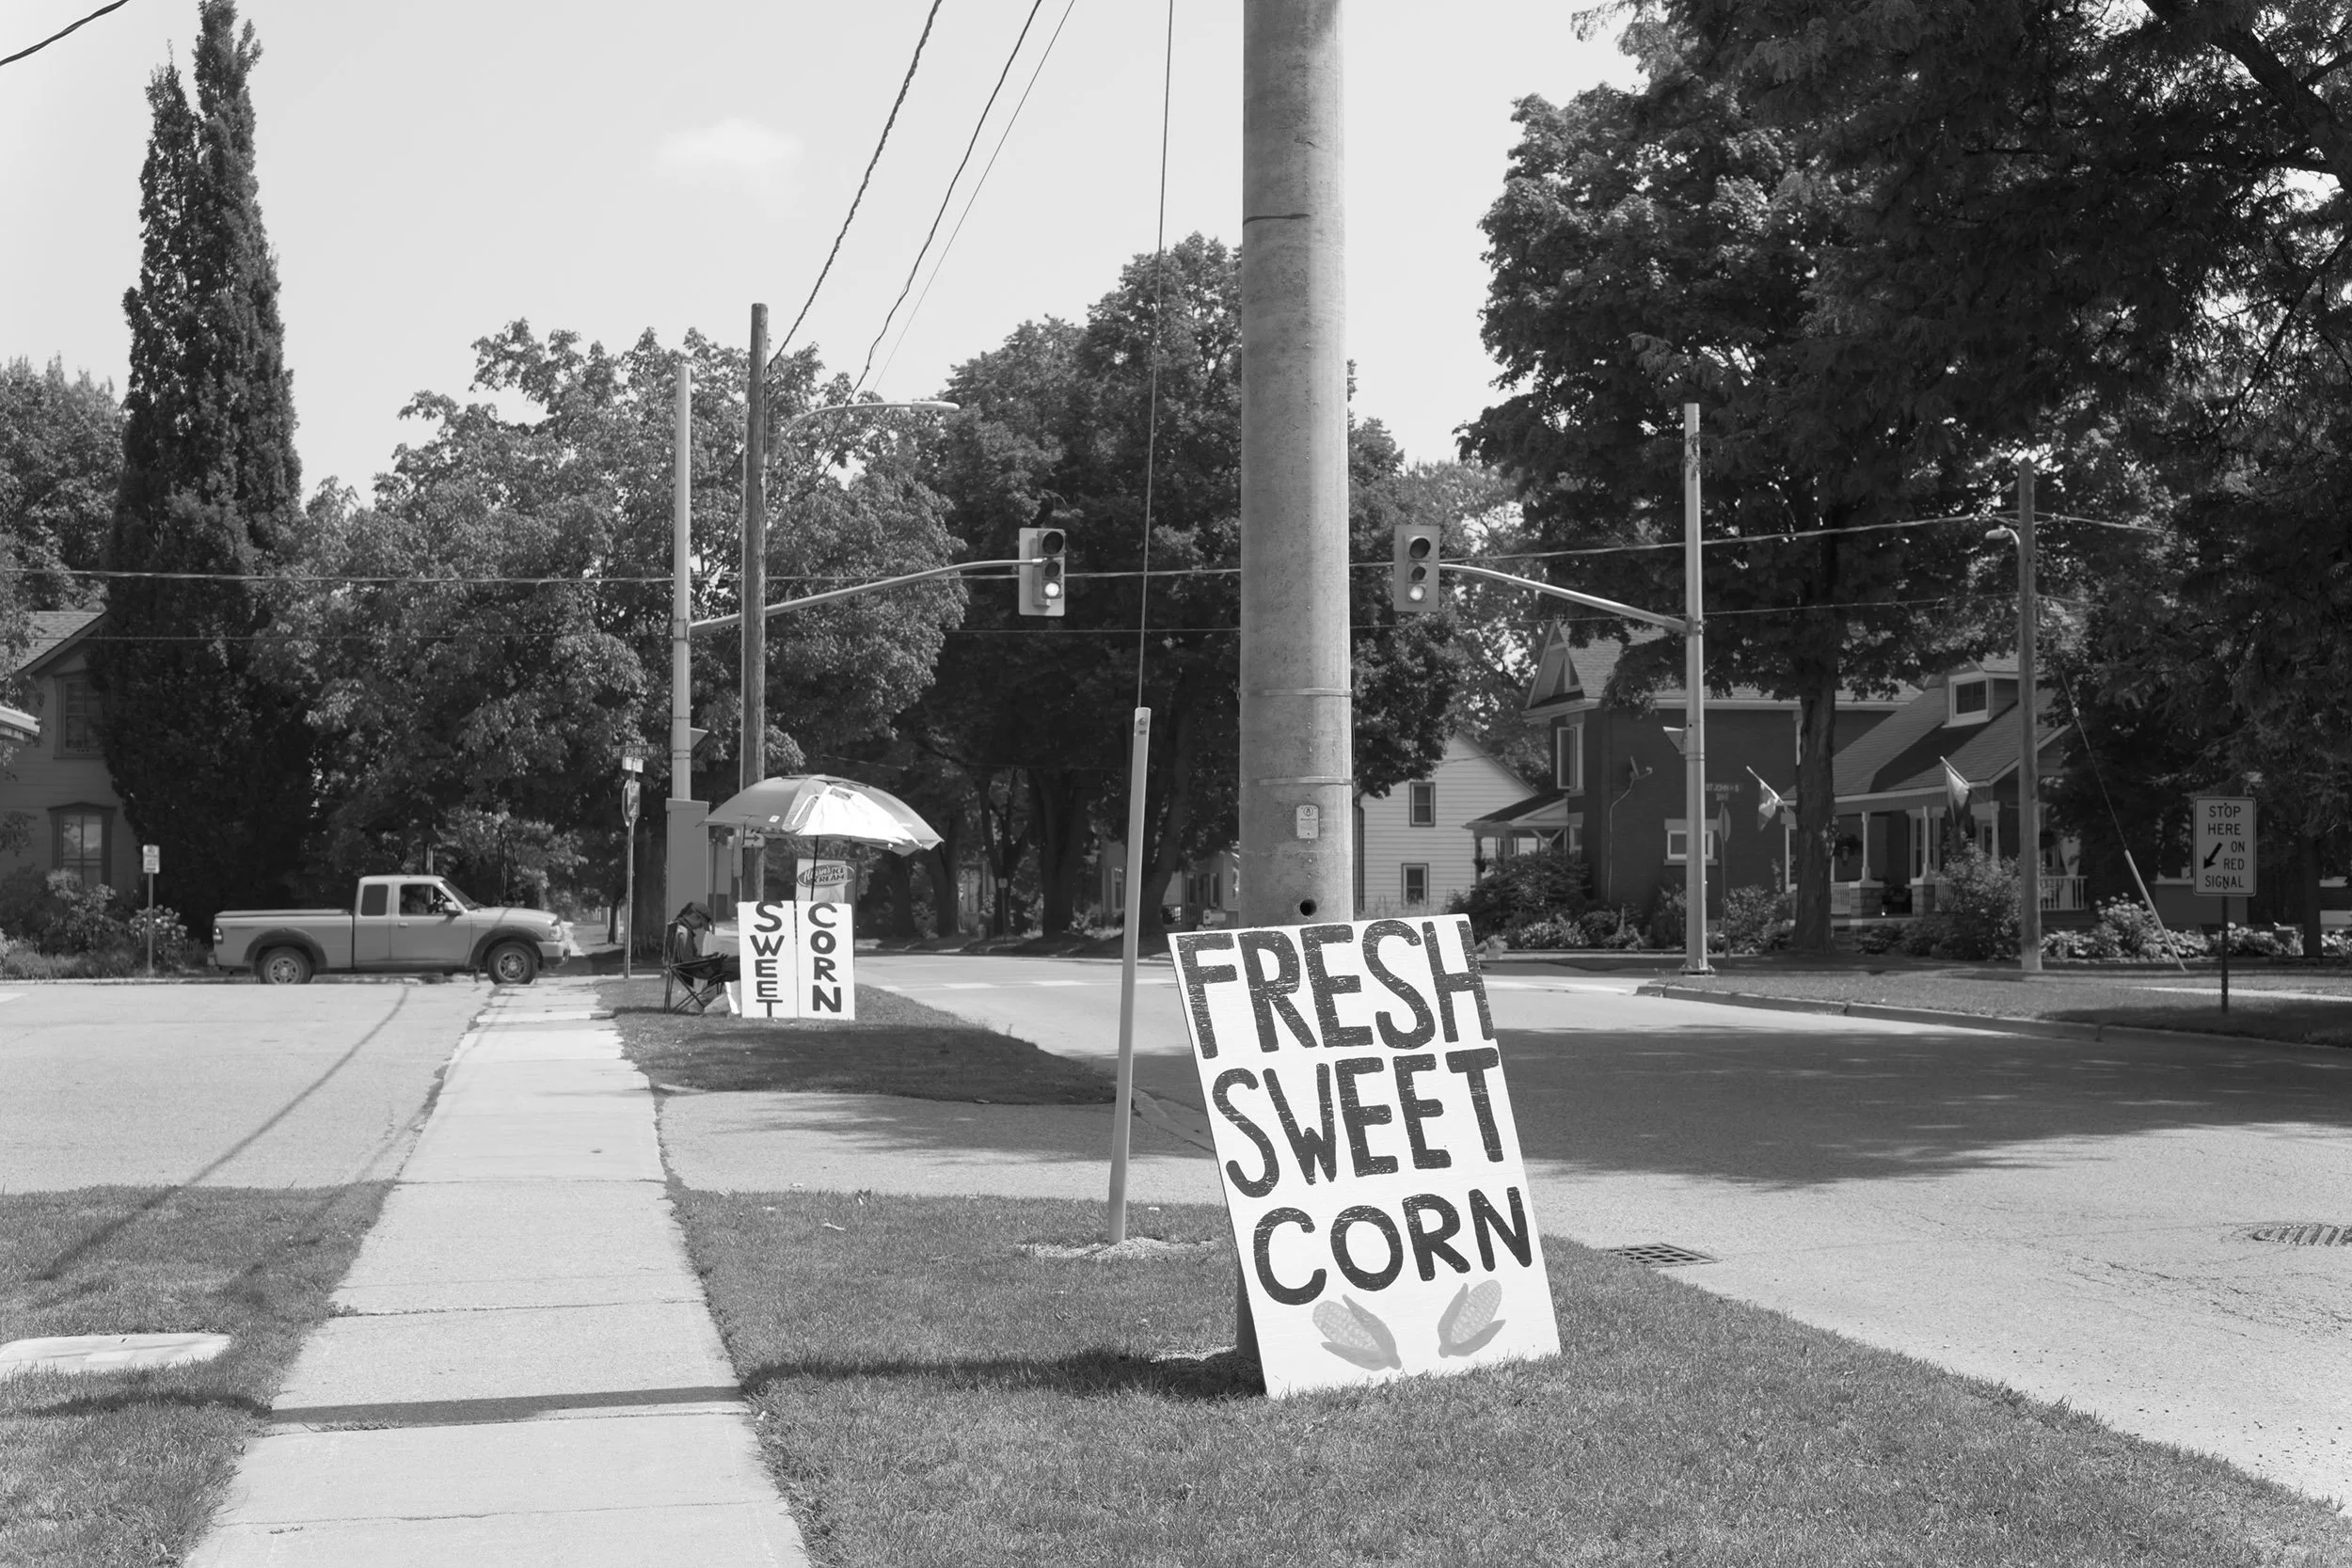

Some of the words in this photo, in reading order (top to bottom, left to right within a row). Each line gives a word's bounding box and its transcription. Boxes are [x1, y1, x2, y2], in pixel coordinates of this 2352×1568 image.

[2207, 823, 2241, 835] HERE
[2208, 805, 2241, 817] STOP
[2223, 858, 2245, 870] RED
[2231, 841, 2246, 853] ON
[2204, 875, 2244, 888] SIGNAL
[750, 901, 785, 1018] SWEET
[807, 902, 842, 1013] CORN
[1176, 920, 1496, 1059] FRESH
[1212, 1047, 1504, 1198] SWEET
[1253, 1186, 1533, 1306] CORN
